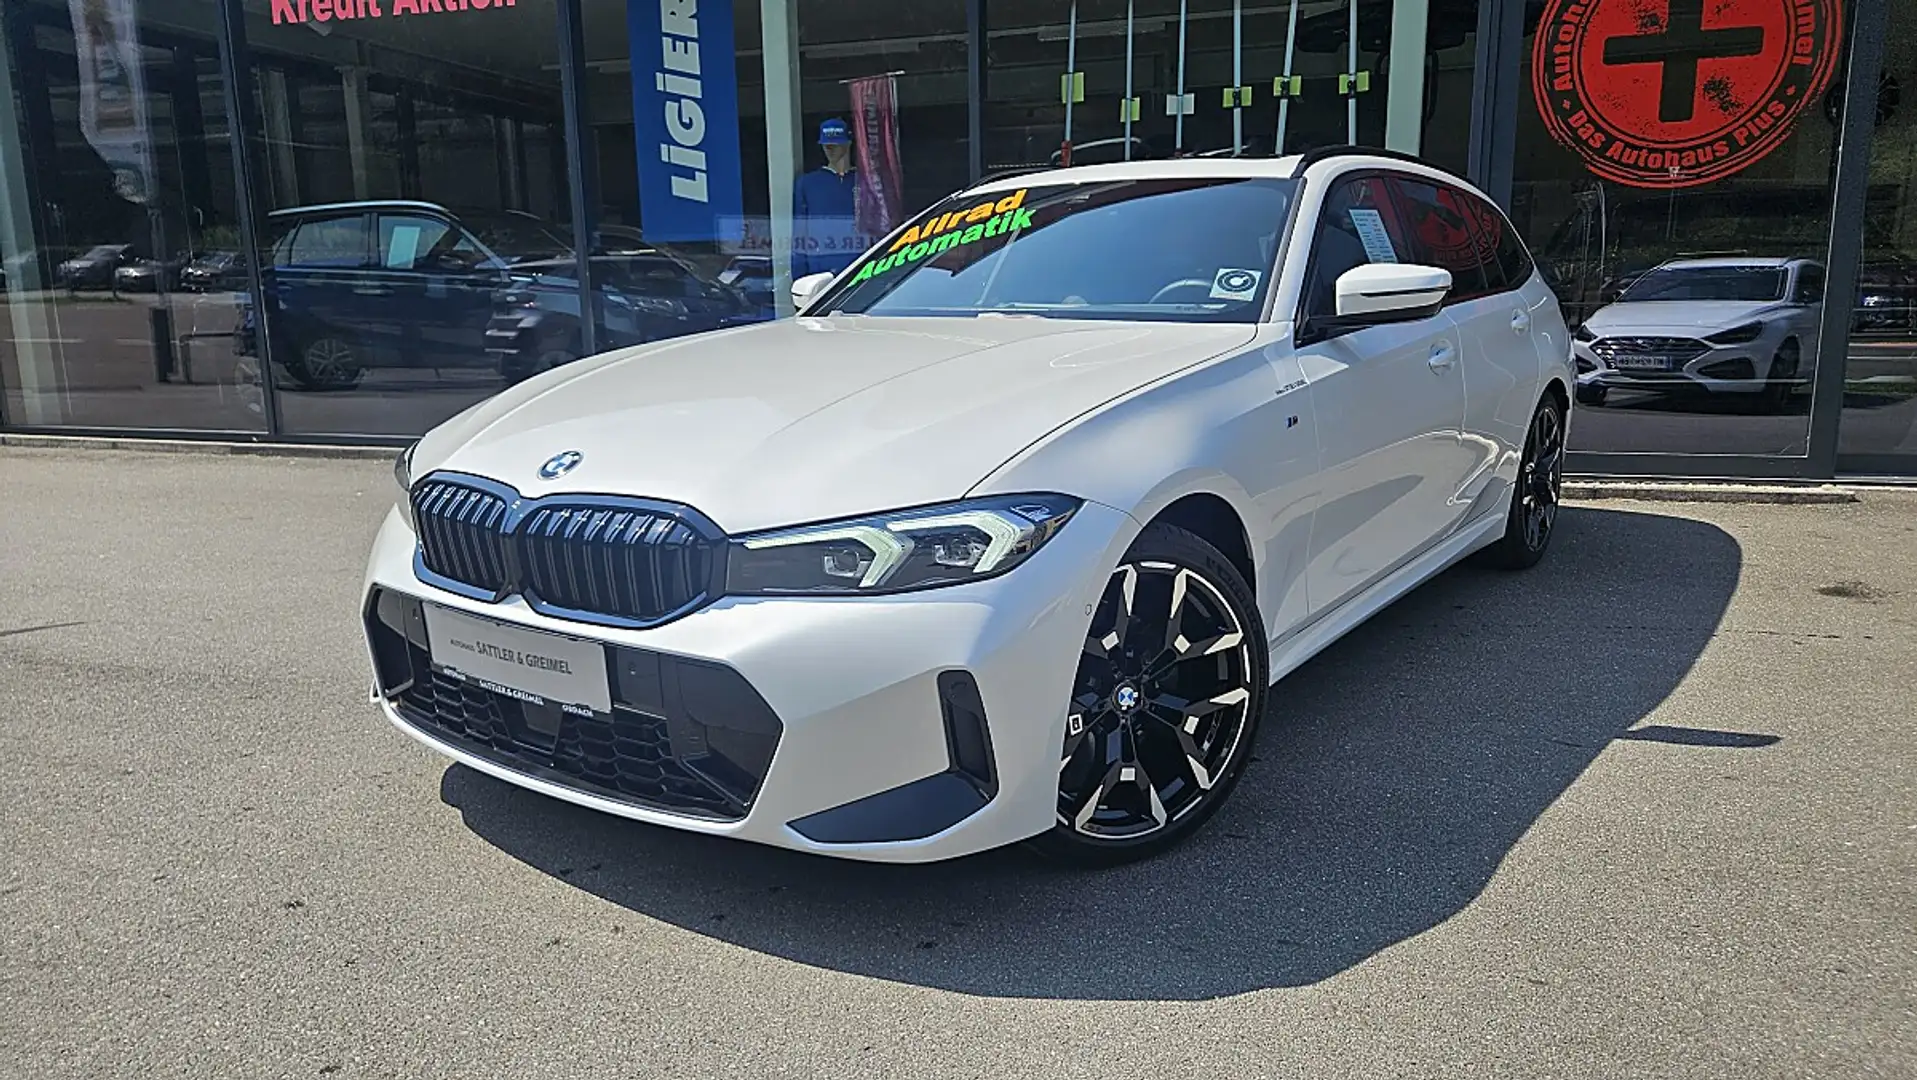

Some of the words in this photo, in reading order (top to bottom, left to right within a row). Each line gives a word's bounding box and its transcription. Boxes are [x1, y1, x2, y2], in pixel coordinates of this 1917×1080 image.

[1553, 0, 1588, 91] Autoh
[1567, 109, 1607, 149] Das
[1605, 140, 1730, 168] Autohaus
[1732, 100, 1787, 146] Plus
[847, 207, 1037, 287] Automatik
[888, 189, 1027, 252] Allrad
[476, 641, 516, 663] SATTLER
[517, 651, 525, 666] &
[526, 653, 573, 675] GREIMEL
